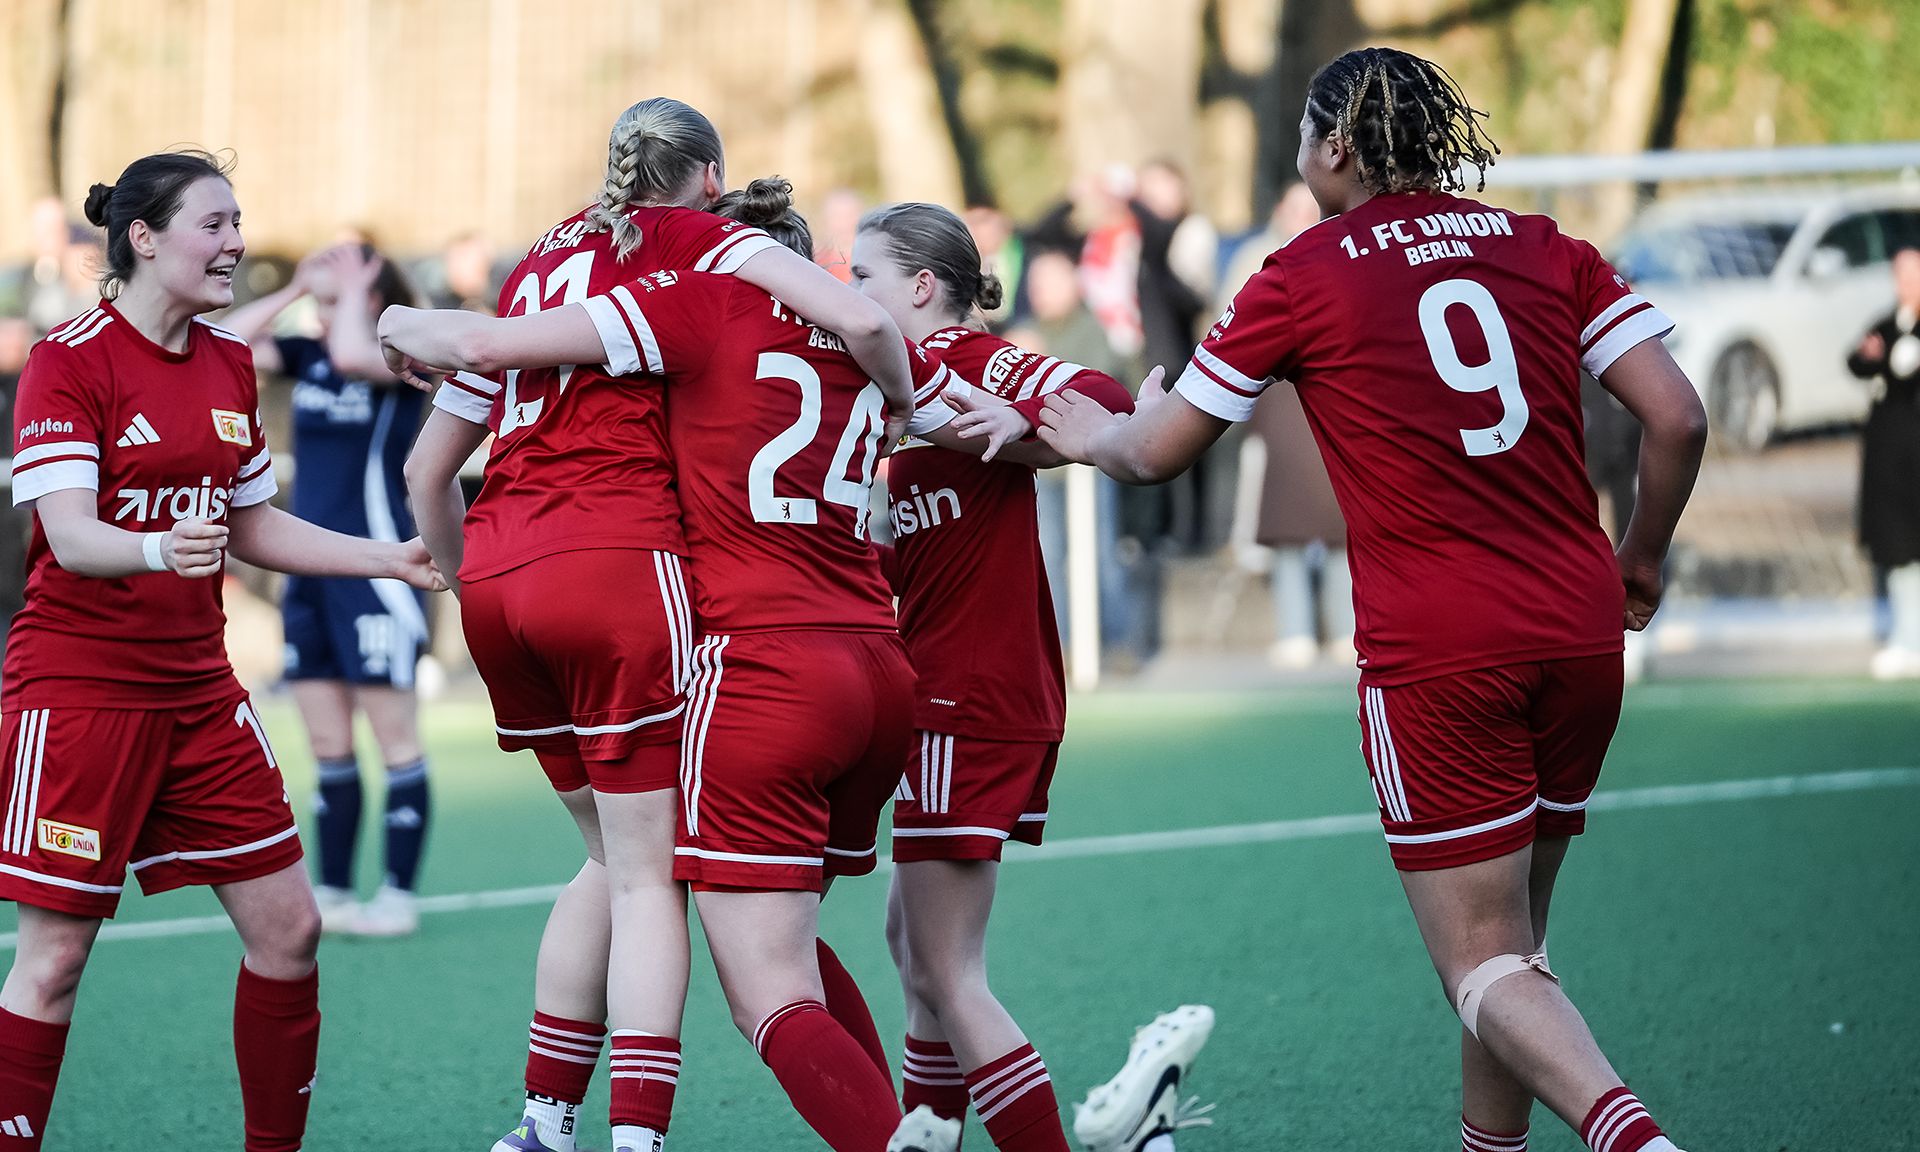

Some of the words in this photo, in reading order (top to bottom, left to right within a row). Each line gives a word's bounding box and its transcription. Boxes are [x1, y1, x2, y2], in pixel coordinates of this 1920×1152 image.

[1340, 235, 1369, 259] 1.
[1371, 220, 1415, 250] FC
[1414, 212, 1513, 237] UNION
[1404, 240, 1474, 266] BERLIN
[808, 327, 852, 354] BERL
[1418, 279, 1529, 456] 9
[748, 352, 887, 540] 24
